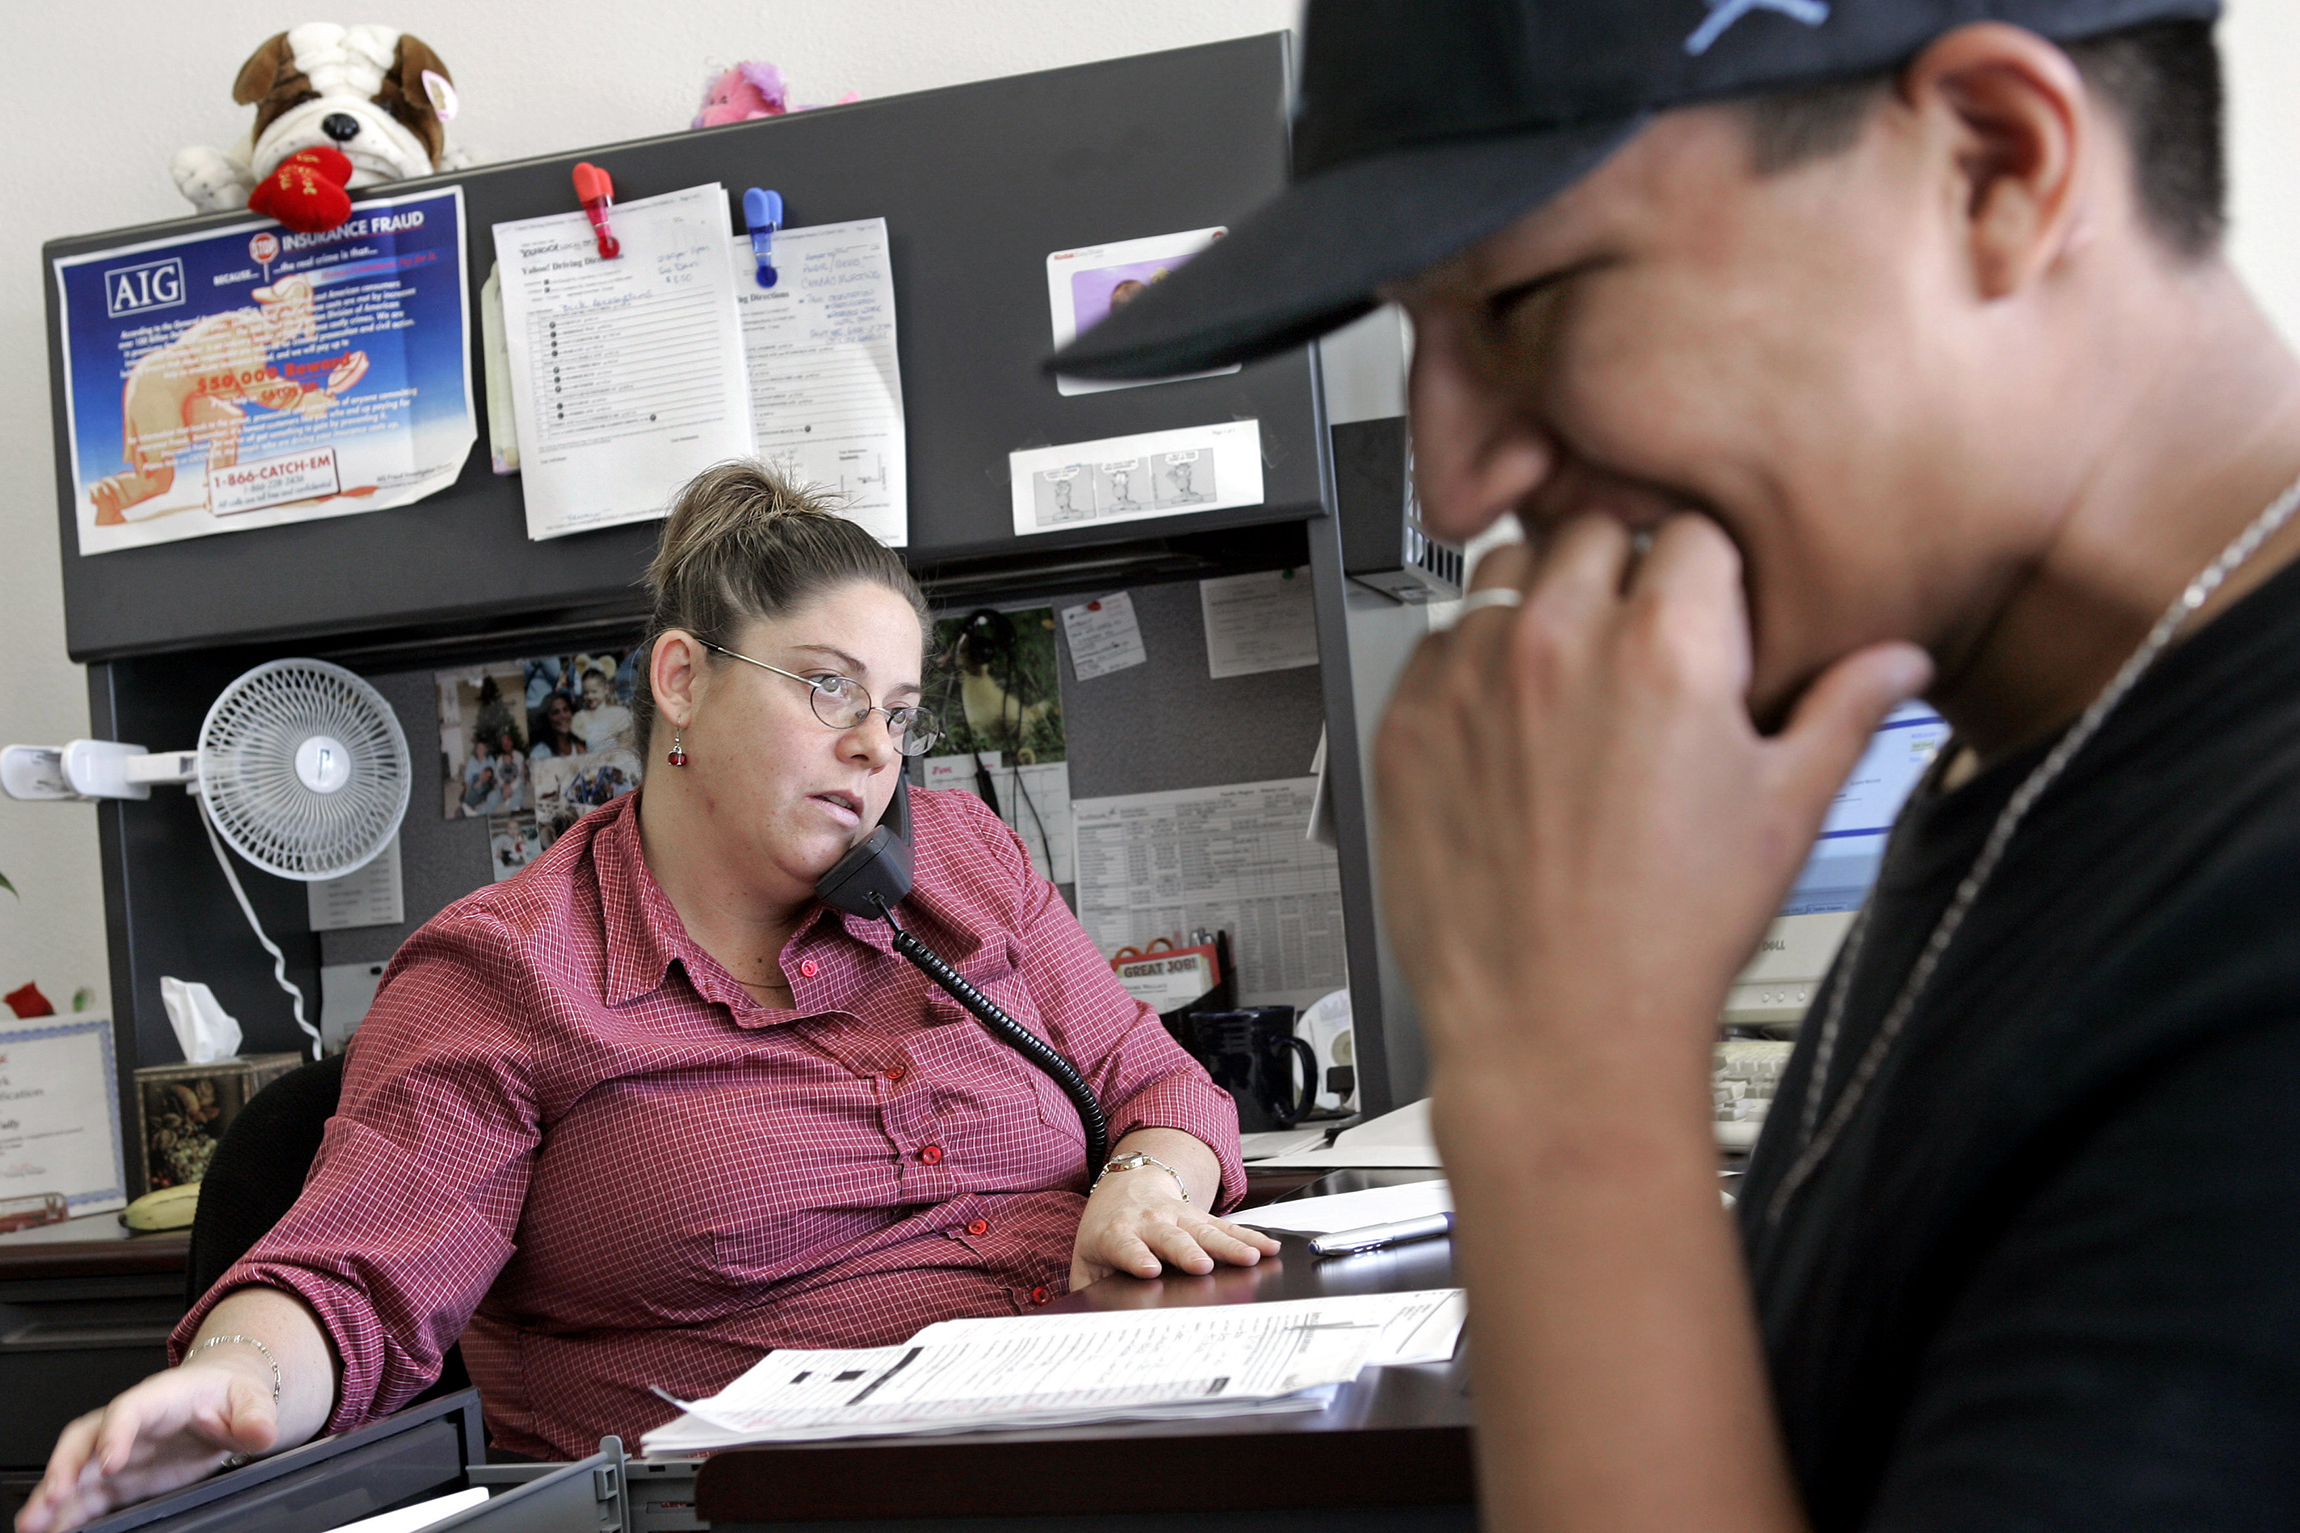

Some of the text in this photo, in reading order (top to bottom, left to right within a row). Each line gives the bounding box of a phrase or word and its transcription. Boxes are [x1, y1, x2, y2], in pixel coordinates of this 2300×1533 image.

[251, 211, 424, 256] STOP INSURANCE FRAUD
[297, 257, 314, 269] real
[316, 254, 338, 266] crime
[522, 264, 550, 275] Yahoo!
[552, 259, 582, 272] Driving
[113, 266, 180, 311] AIG
[750, 291, 789, 301] Directions
[284, 352, 351, 376] Reward
[214, 455, 330, 488] 1-866-CATCH-EM
[1124, 958, 1197, 978] GREAT JOB!
